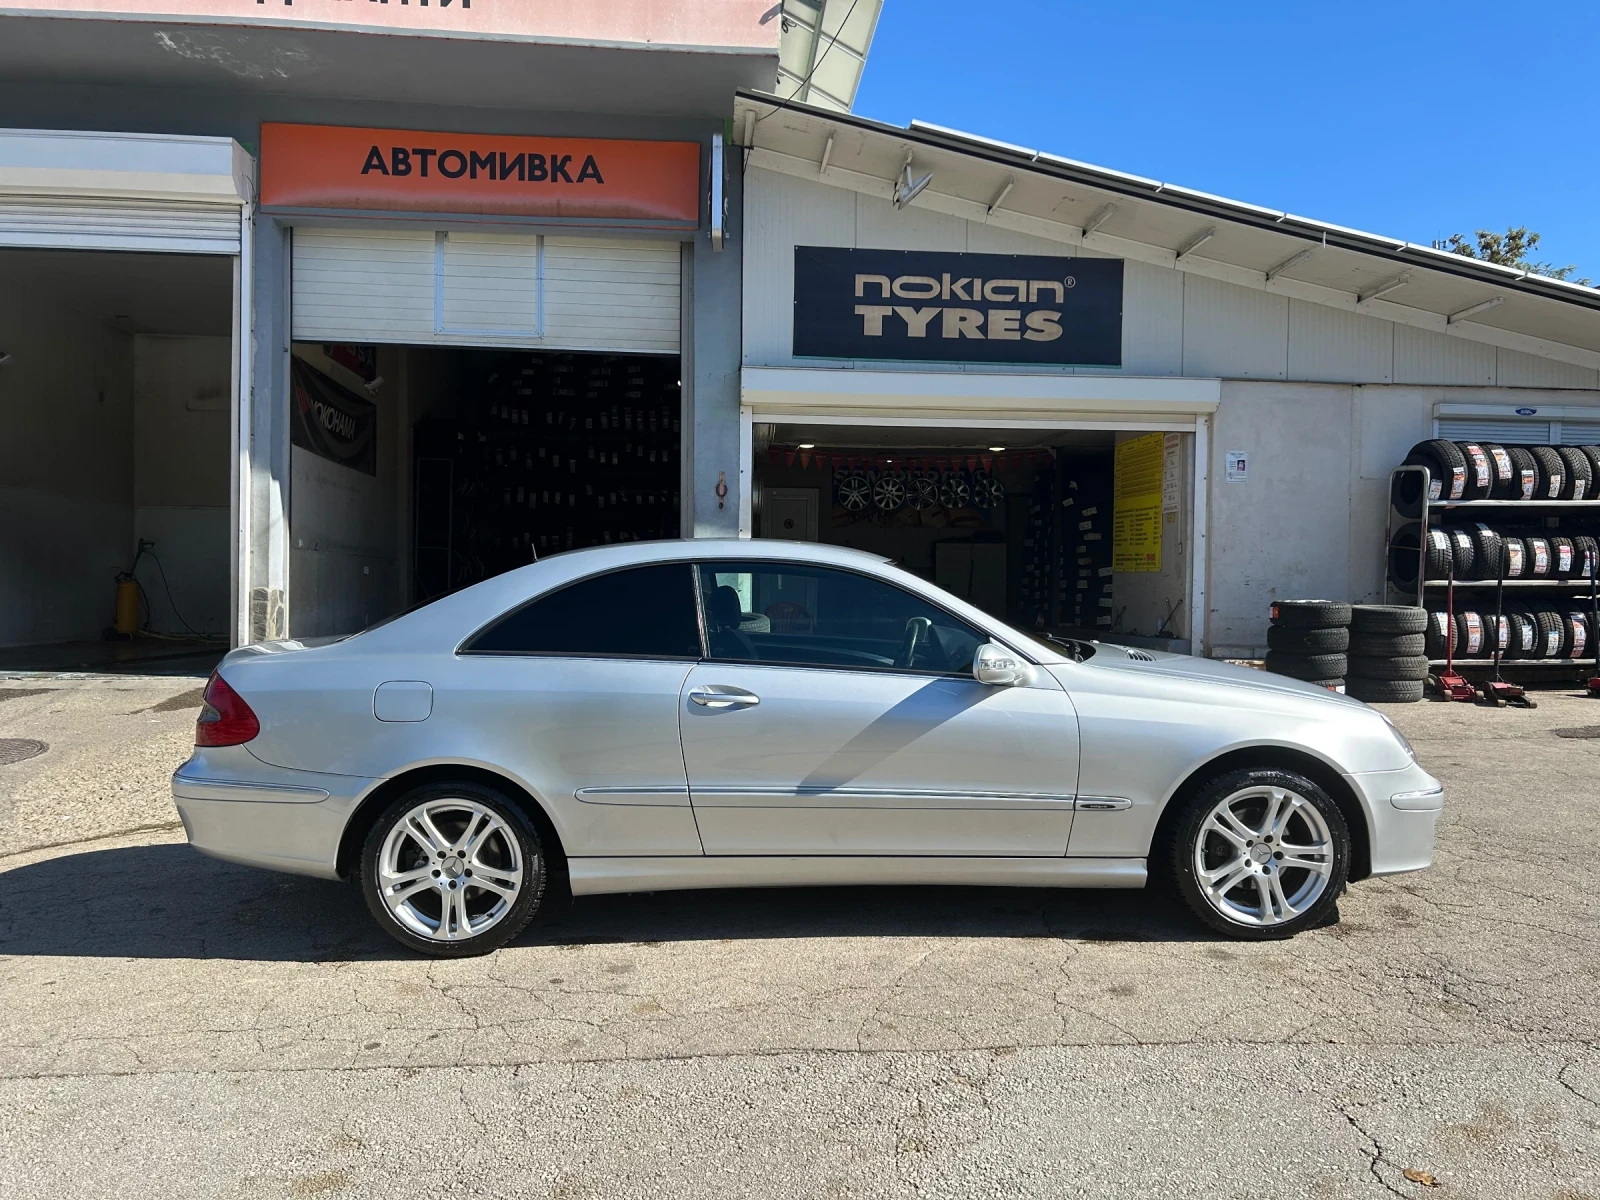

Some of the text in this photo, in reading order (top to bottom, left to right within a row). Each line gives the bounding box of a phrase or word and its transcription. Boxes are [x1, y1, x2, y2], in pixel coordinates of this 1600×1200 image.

[361, 145, 604, 184] АВТОМИВКА
[854, 305, 1063, 342] TYRES
[311, 399, 356, 440] YOKOHAMA
